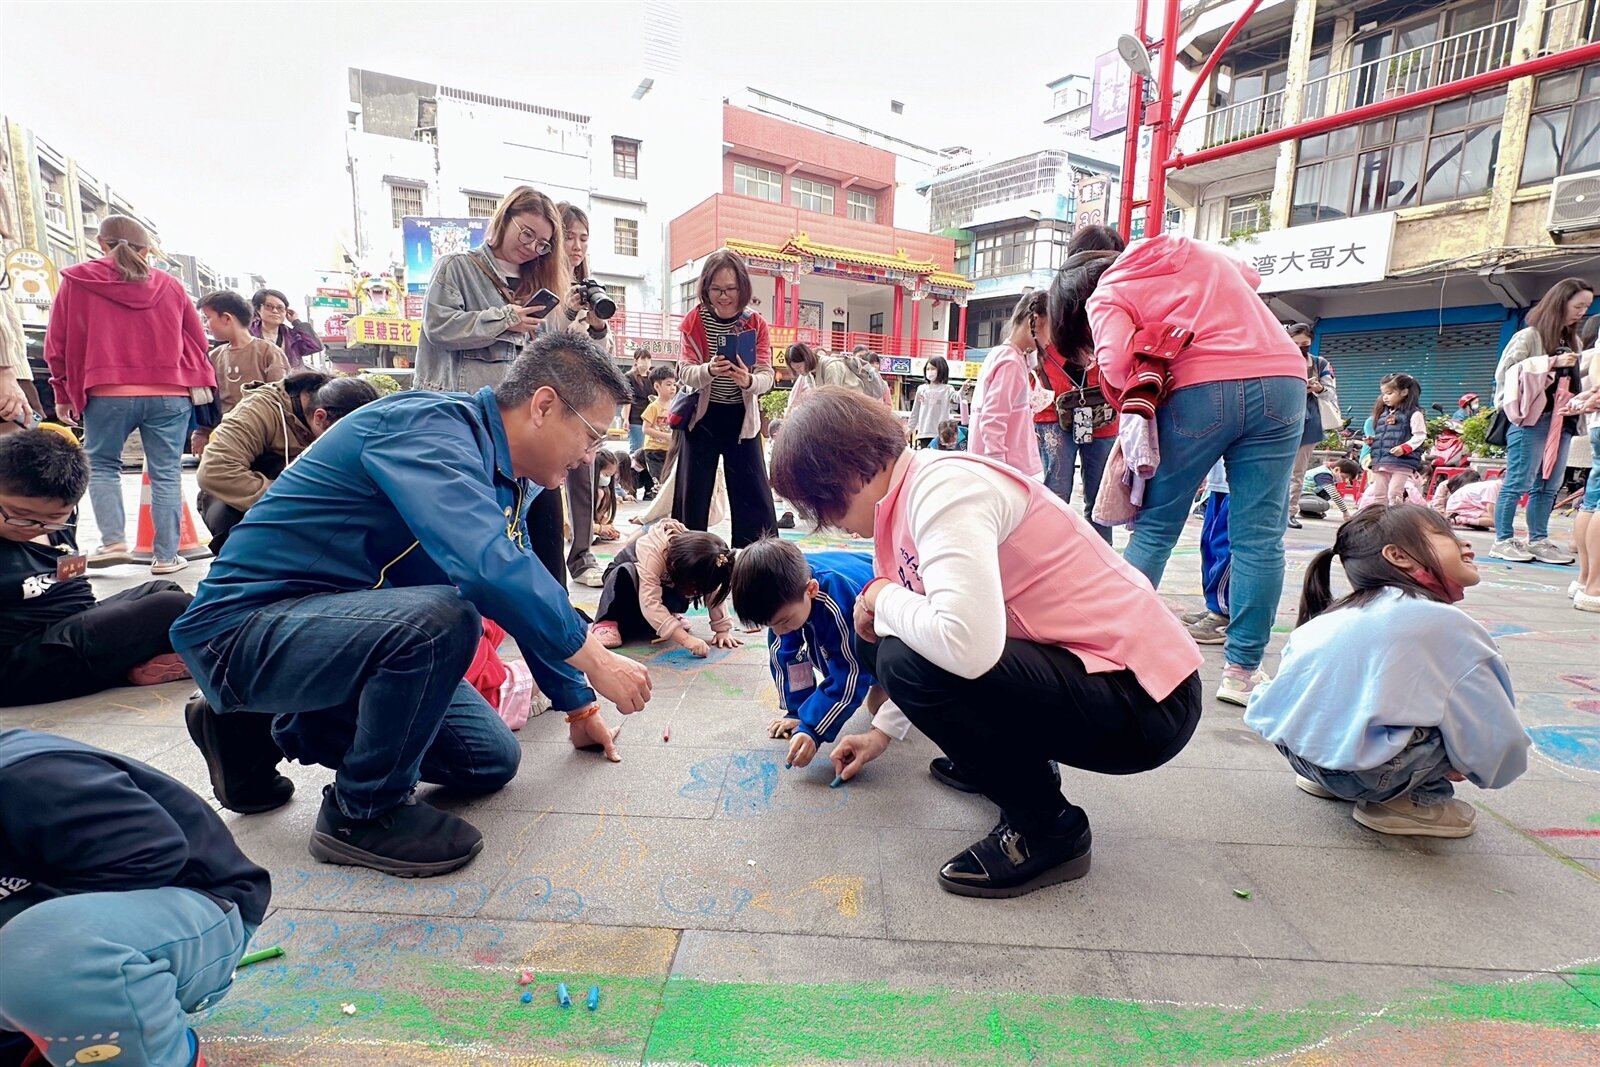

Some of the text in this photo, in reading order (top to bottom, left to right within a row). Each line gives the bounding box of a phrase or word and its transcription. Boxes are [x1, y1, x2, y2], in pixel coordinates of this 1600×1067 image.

[1079, 209, 1101, 230] 3C
[364, 320, 412, 342] 黑糖豆花
